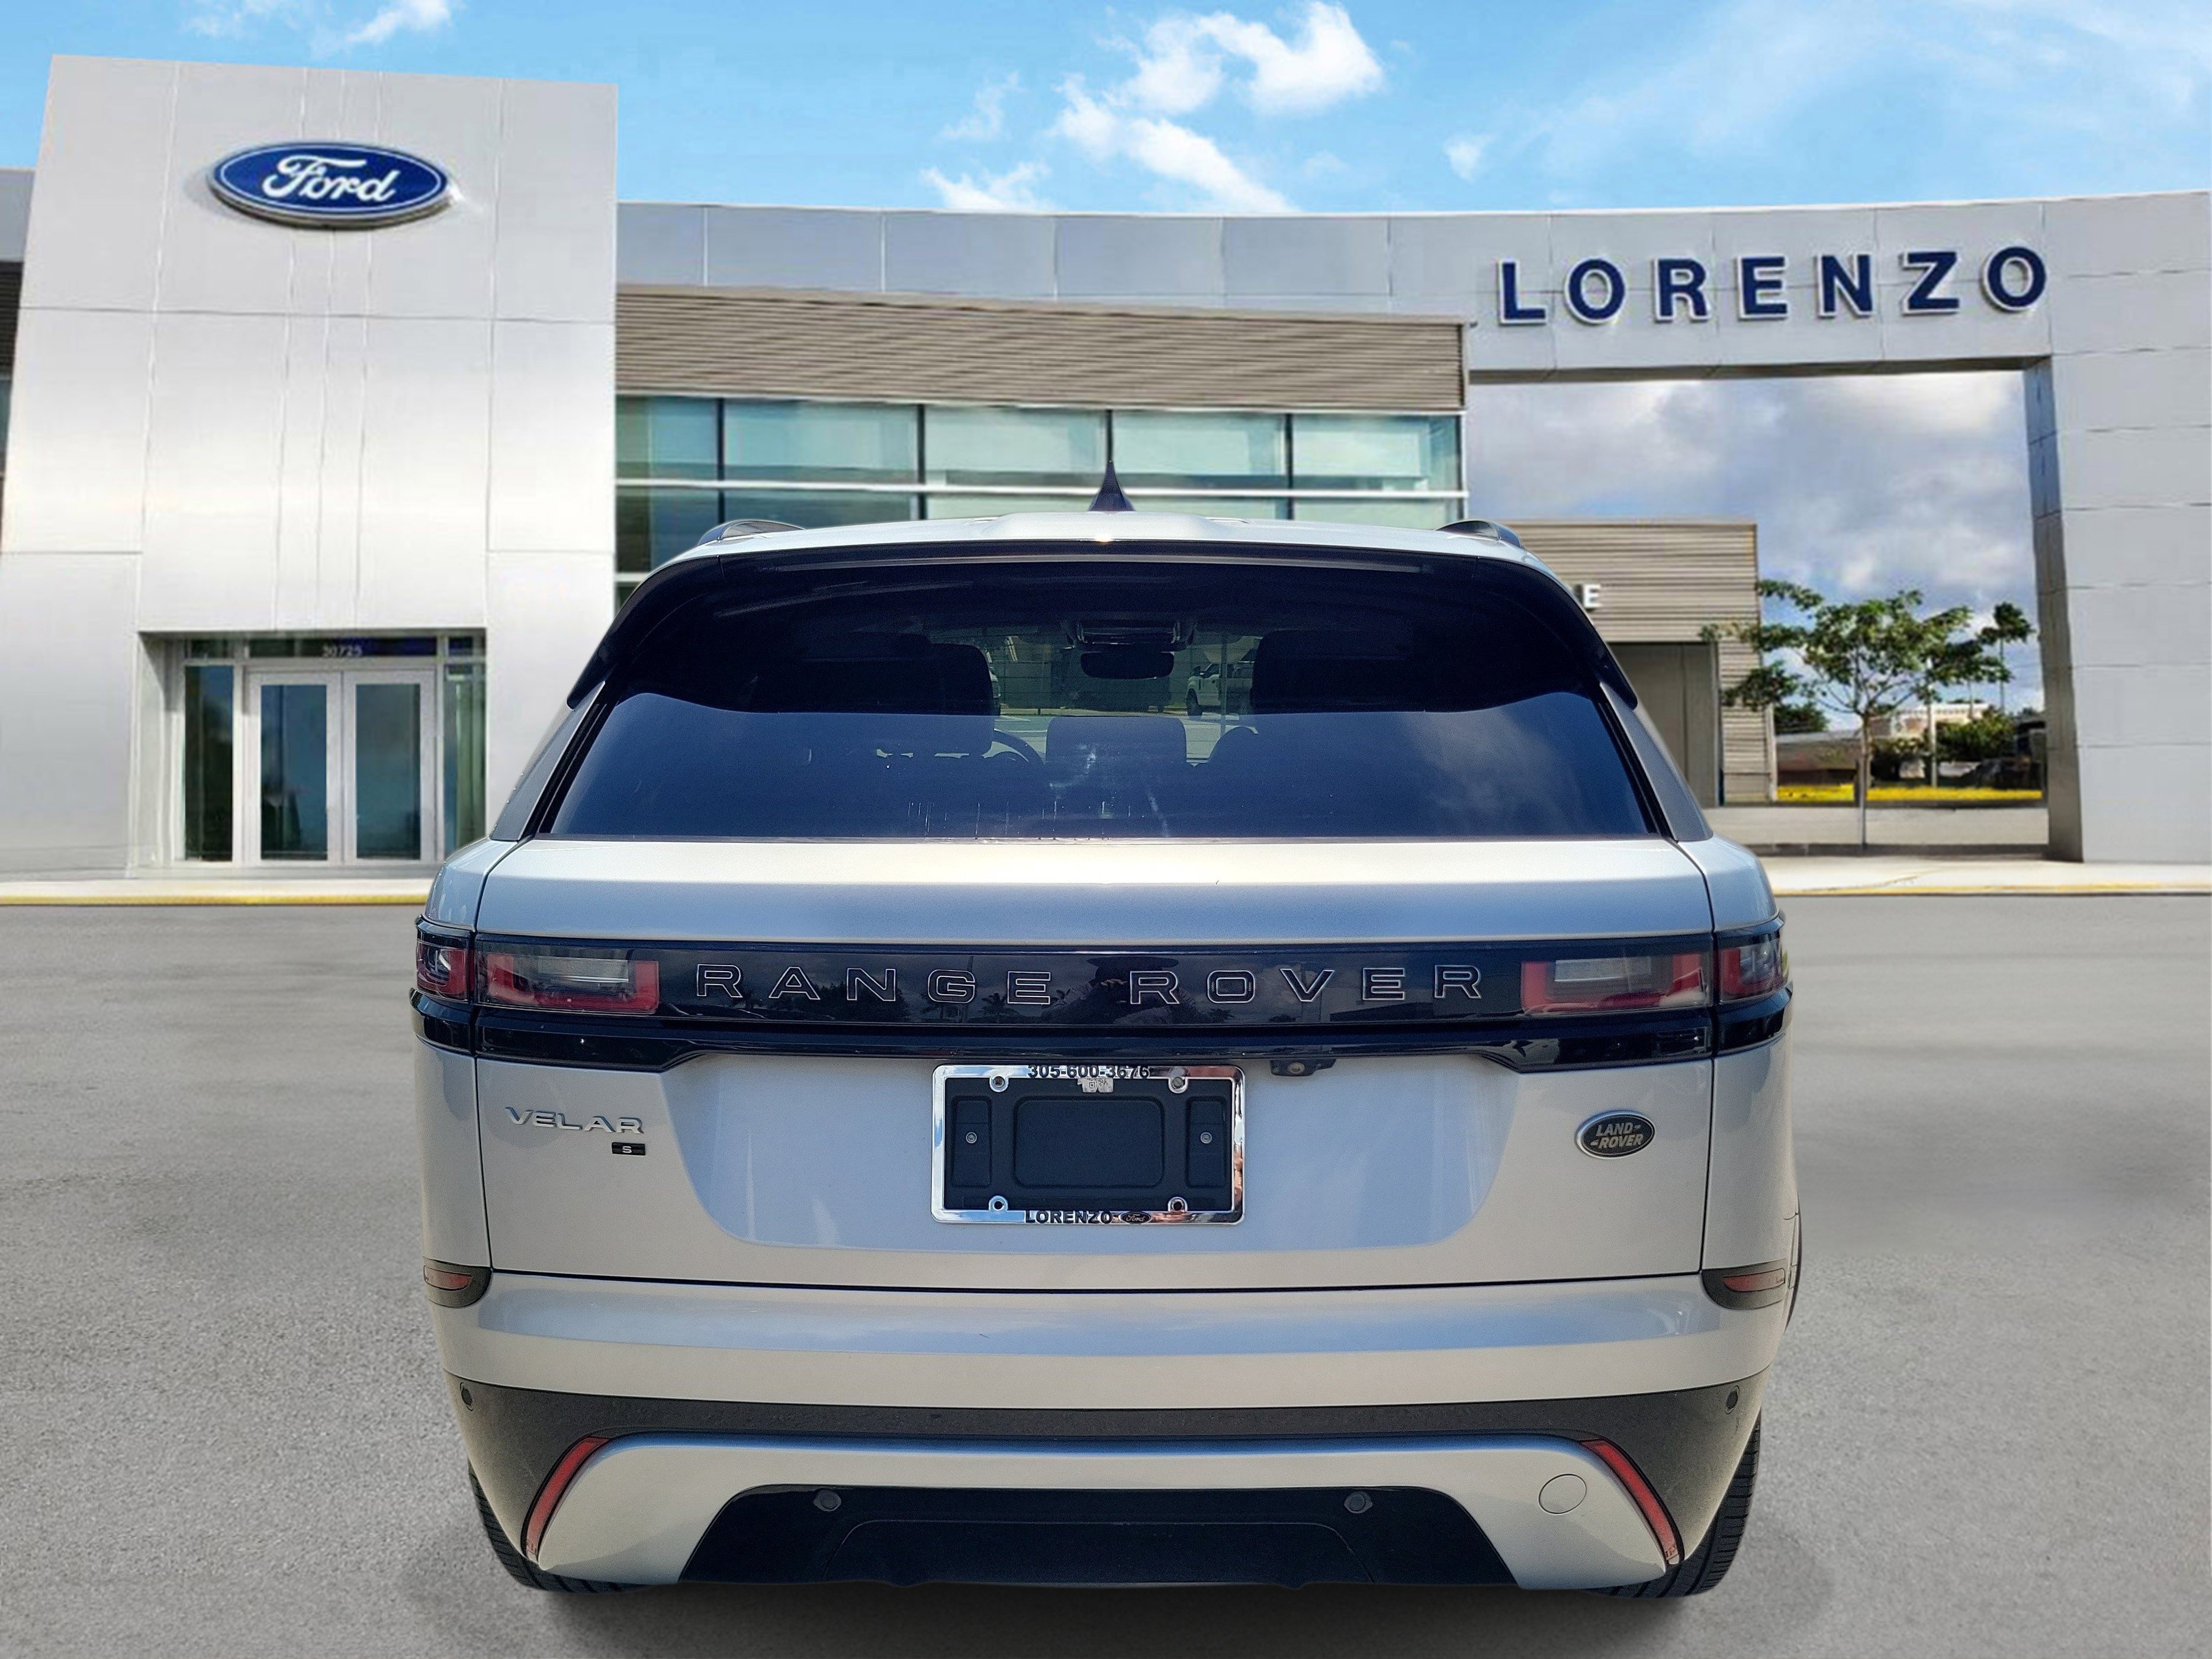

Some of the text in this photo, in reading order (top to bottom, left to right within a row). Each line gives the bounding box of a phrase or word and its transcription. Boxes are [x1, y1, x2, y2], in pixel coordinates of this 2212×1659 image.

[262, 155, 400, 202] Ford
[1499, 246, 2047, 324] LORENZO
[696, 964, 1481, 1005] RANGE ROVER
[1027, 1065, 1150, 1078] 305-600-3676
[505, 1106, 645, 1134] VELAR
[1595, 1121, 1634, 1137] LAND
[1598, 1133, 1644, 1149] ROVER
[622, 1145, 633, 1154] S
[1025, 1210, 1113, 1224] LORENZO
